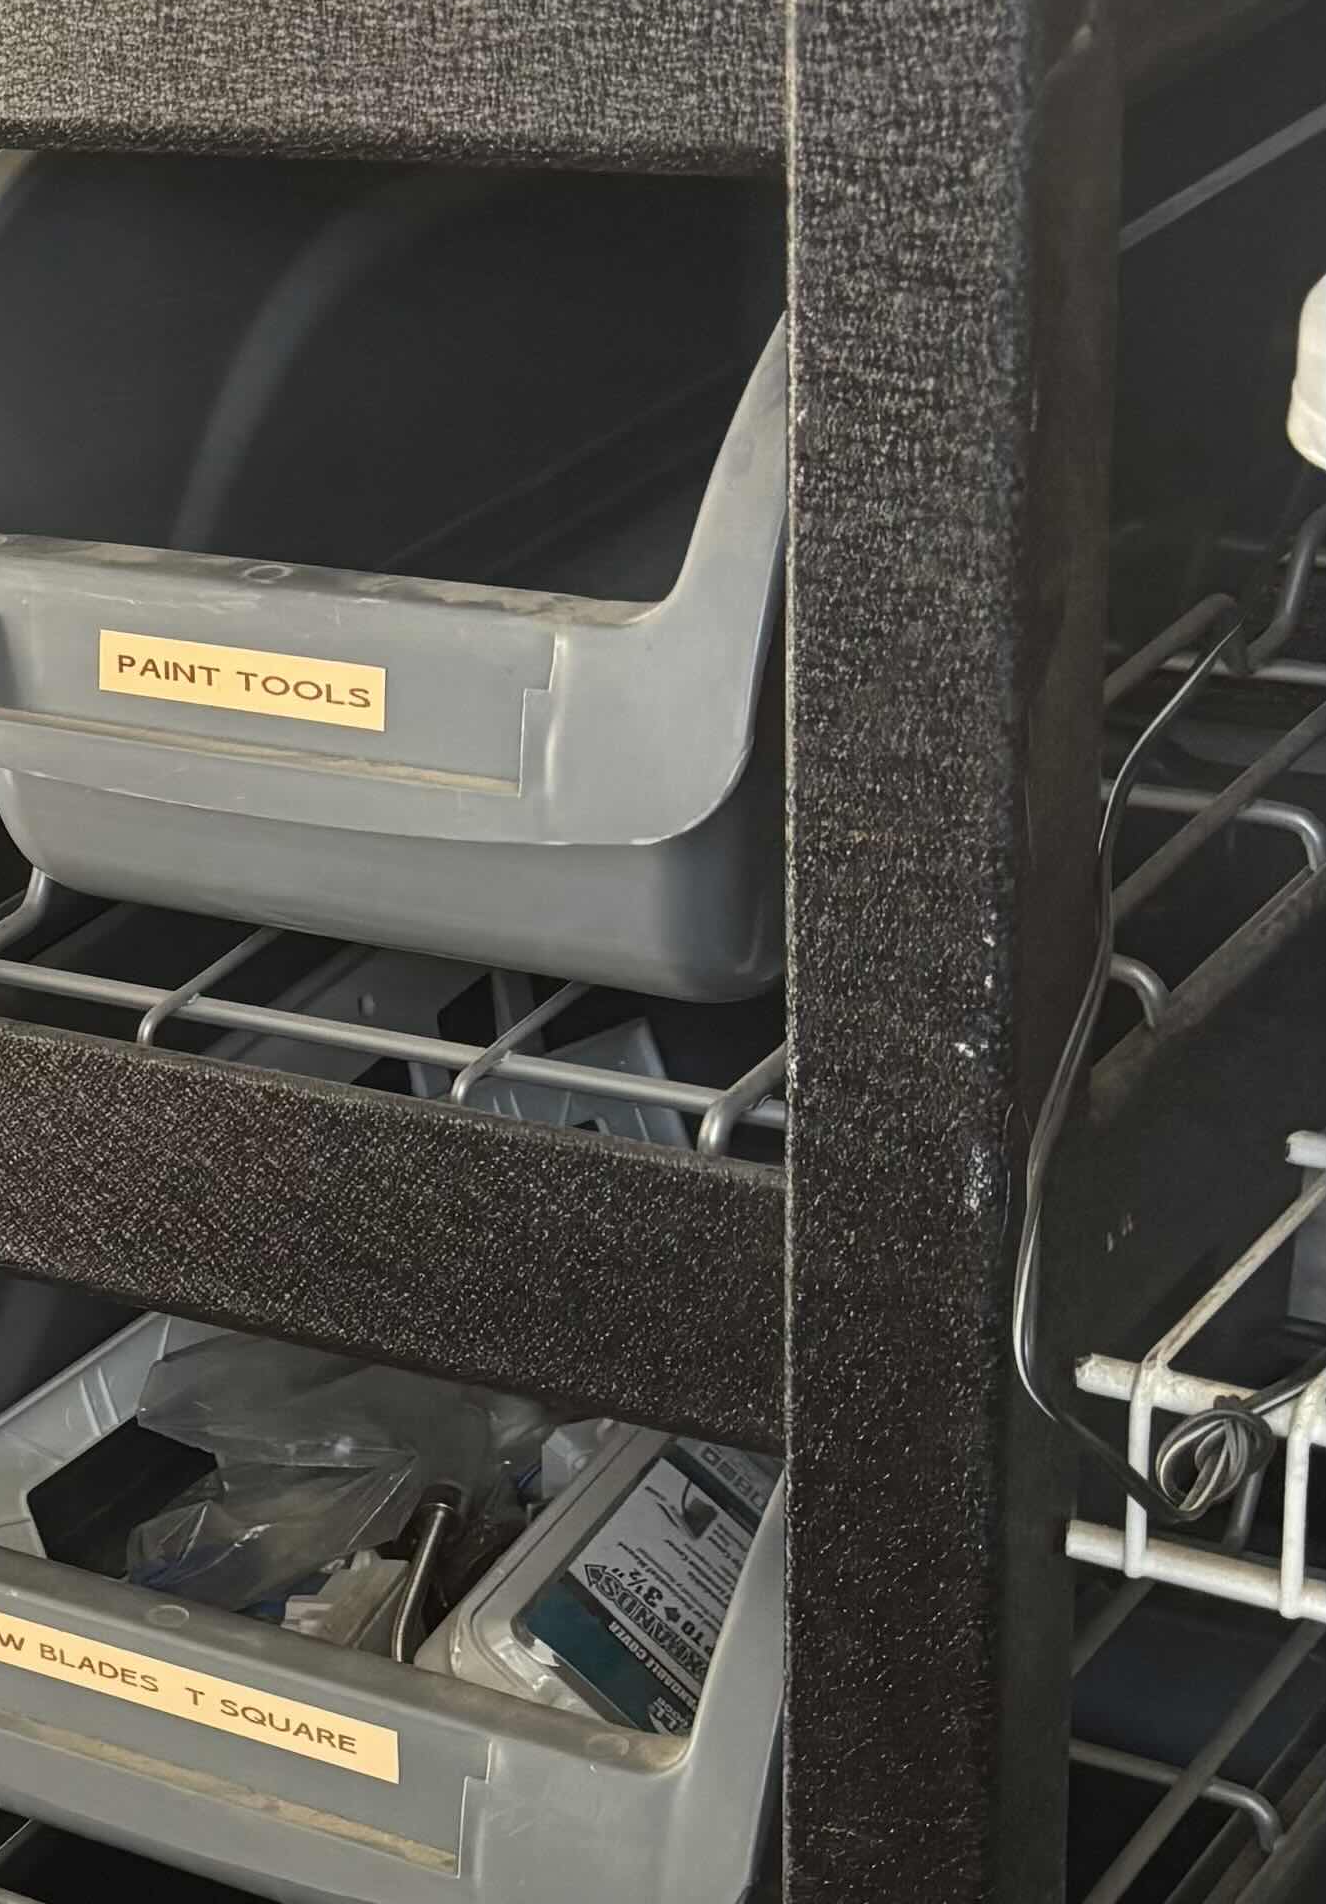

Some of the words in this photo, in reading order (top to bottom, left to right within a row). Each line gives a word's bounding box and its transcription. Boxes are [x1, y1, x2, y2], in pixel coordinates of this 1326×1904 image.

[117, 653, 221, 687] PAINT
[236, 670, 372, 709] TOOLS
[607, 1620, 648, 1662] COVER
[39, 1643, 159, 1694] BLADES
[185, 1686, 205, 1707] T
[220, 1698, 358, 1756] SQUARE
